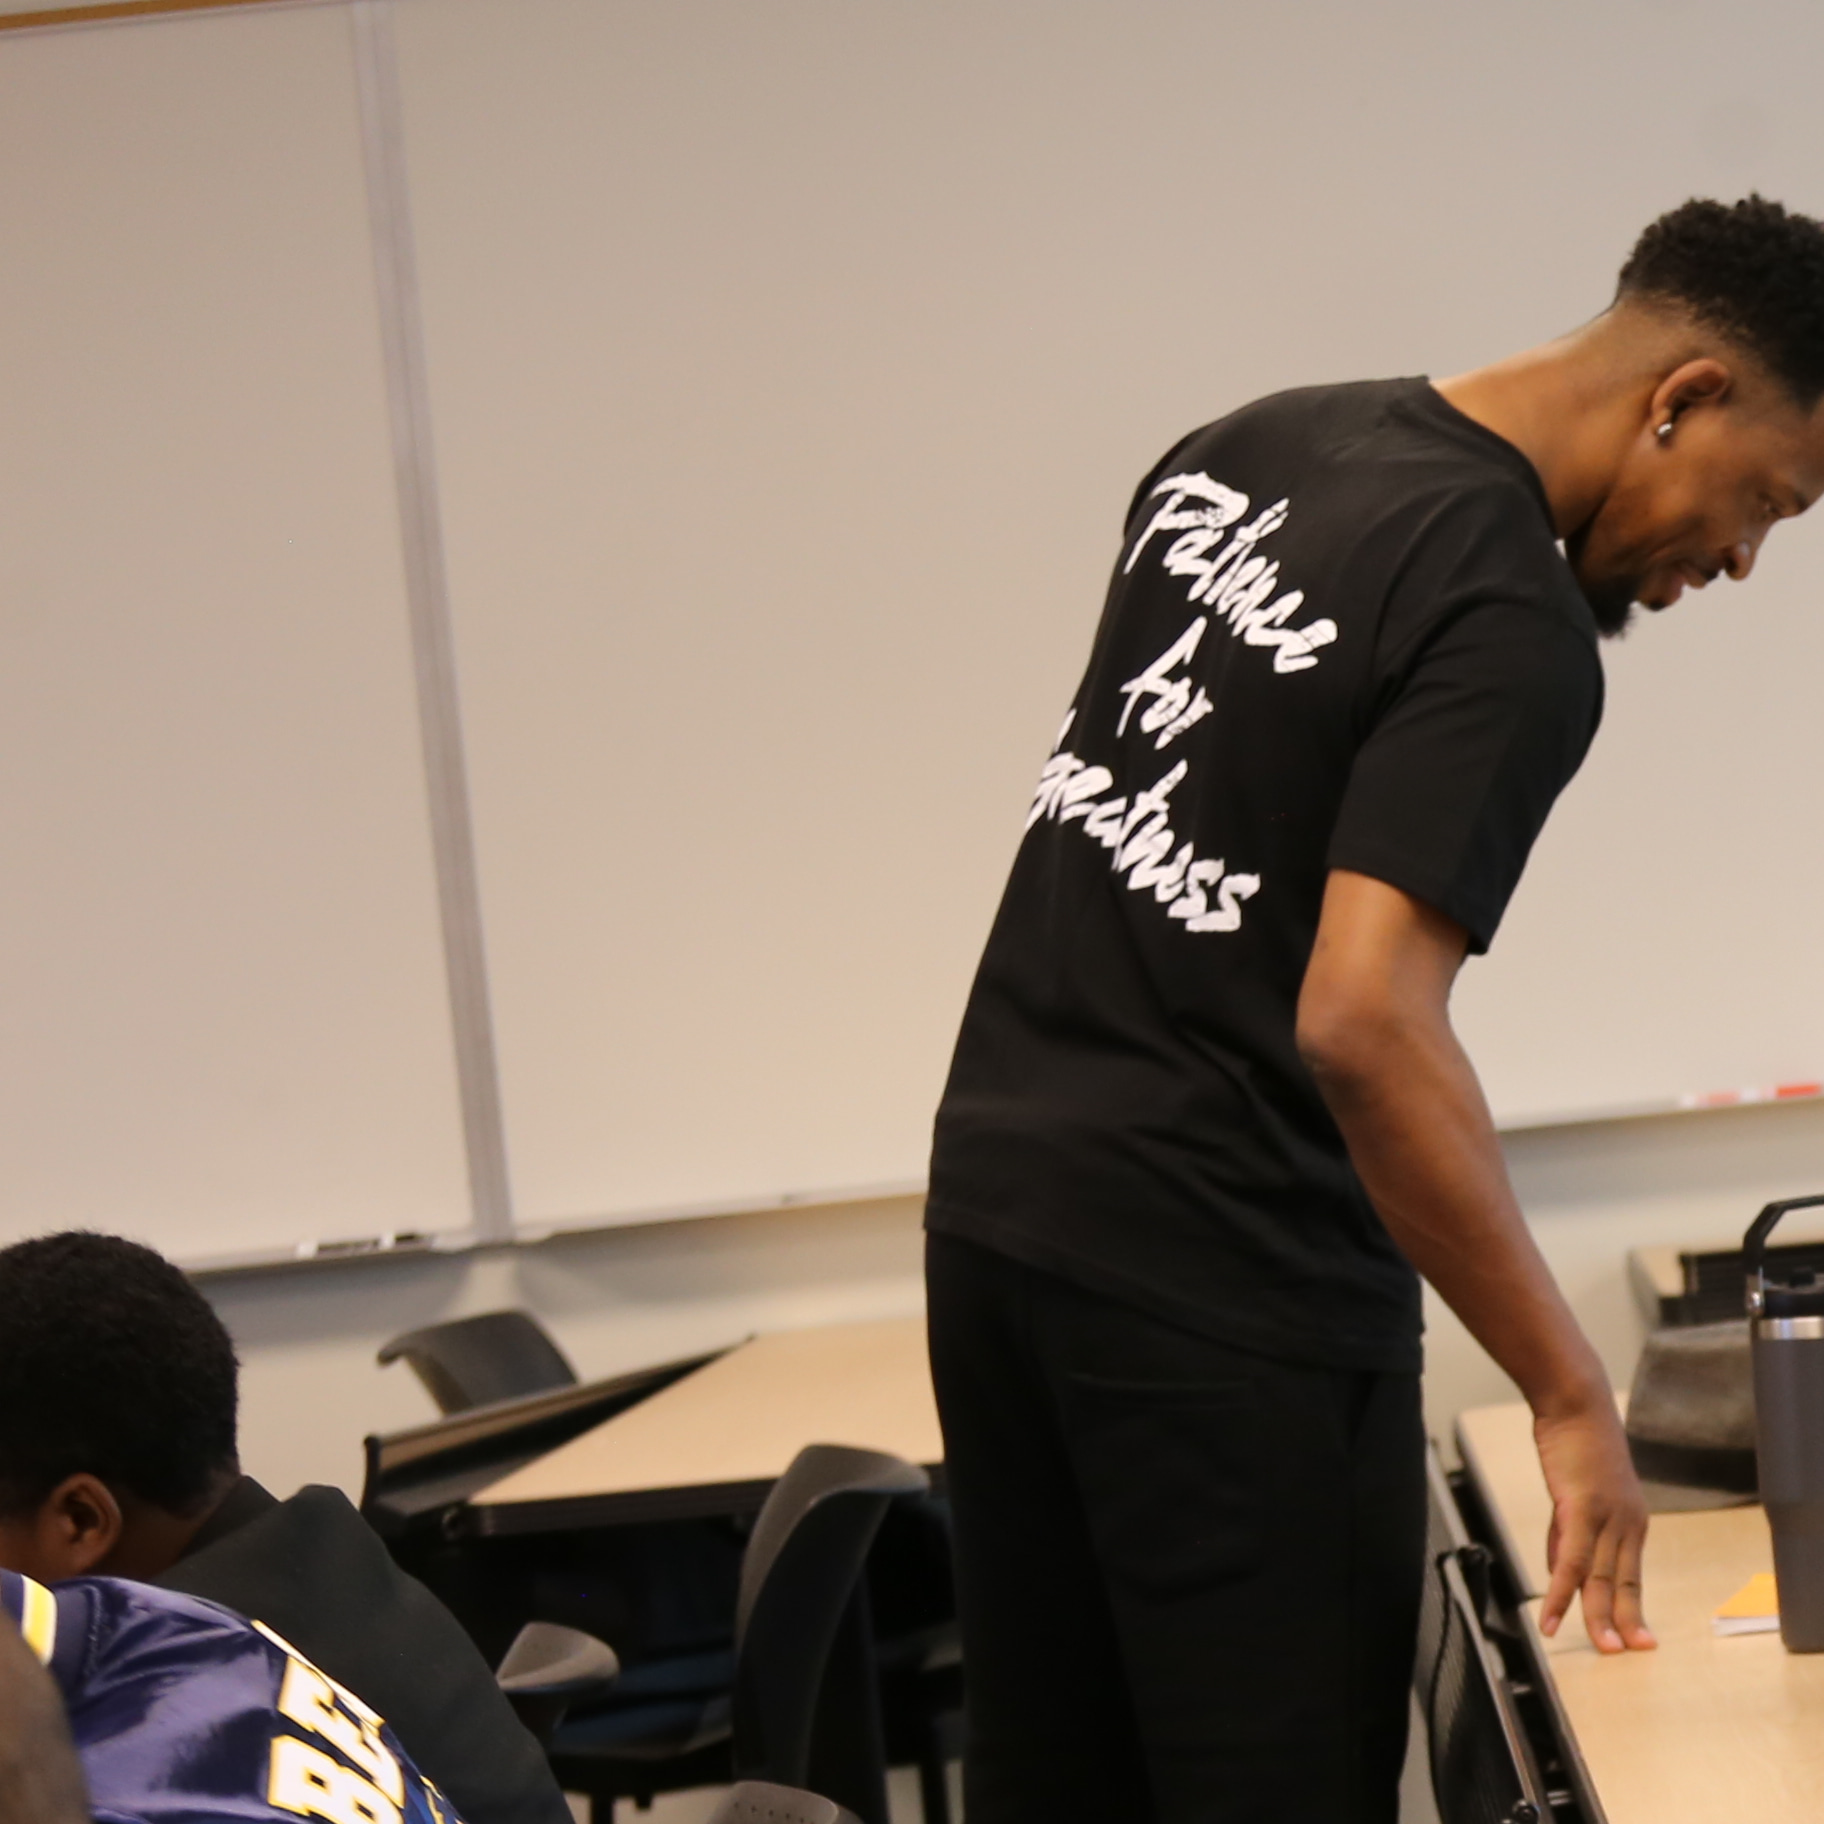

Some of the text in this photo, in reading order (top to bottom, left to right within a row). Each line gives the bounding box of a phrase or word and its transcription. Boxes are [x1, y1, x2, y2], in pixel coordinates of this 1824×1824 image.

[1123, 470, 1339, 674] Patience
[1115, 615, 1215, 751] for
[1023, 707, 1261, 933] reatness
